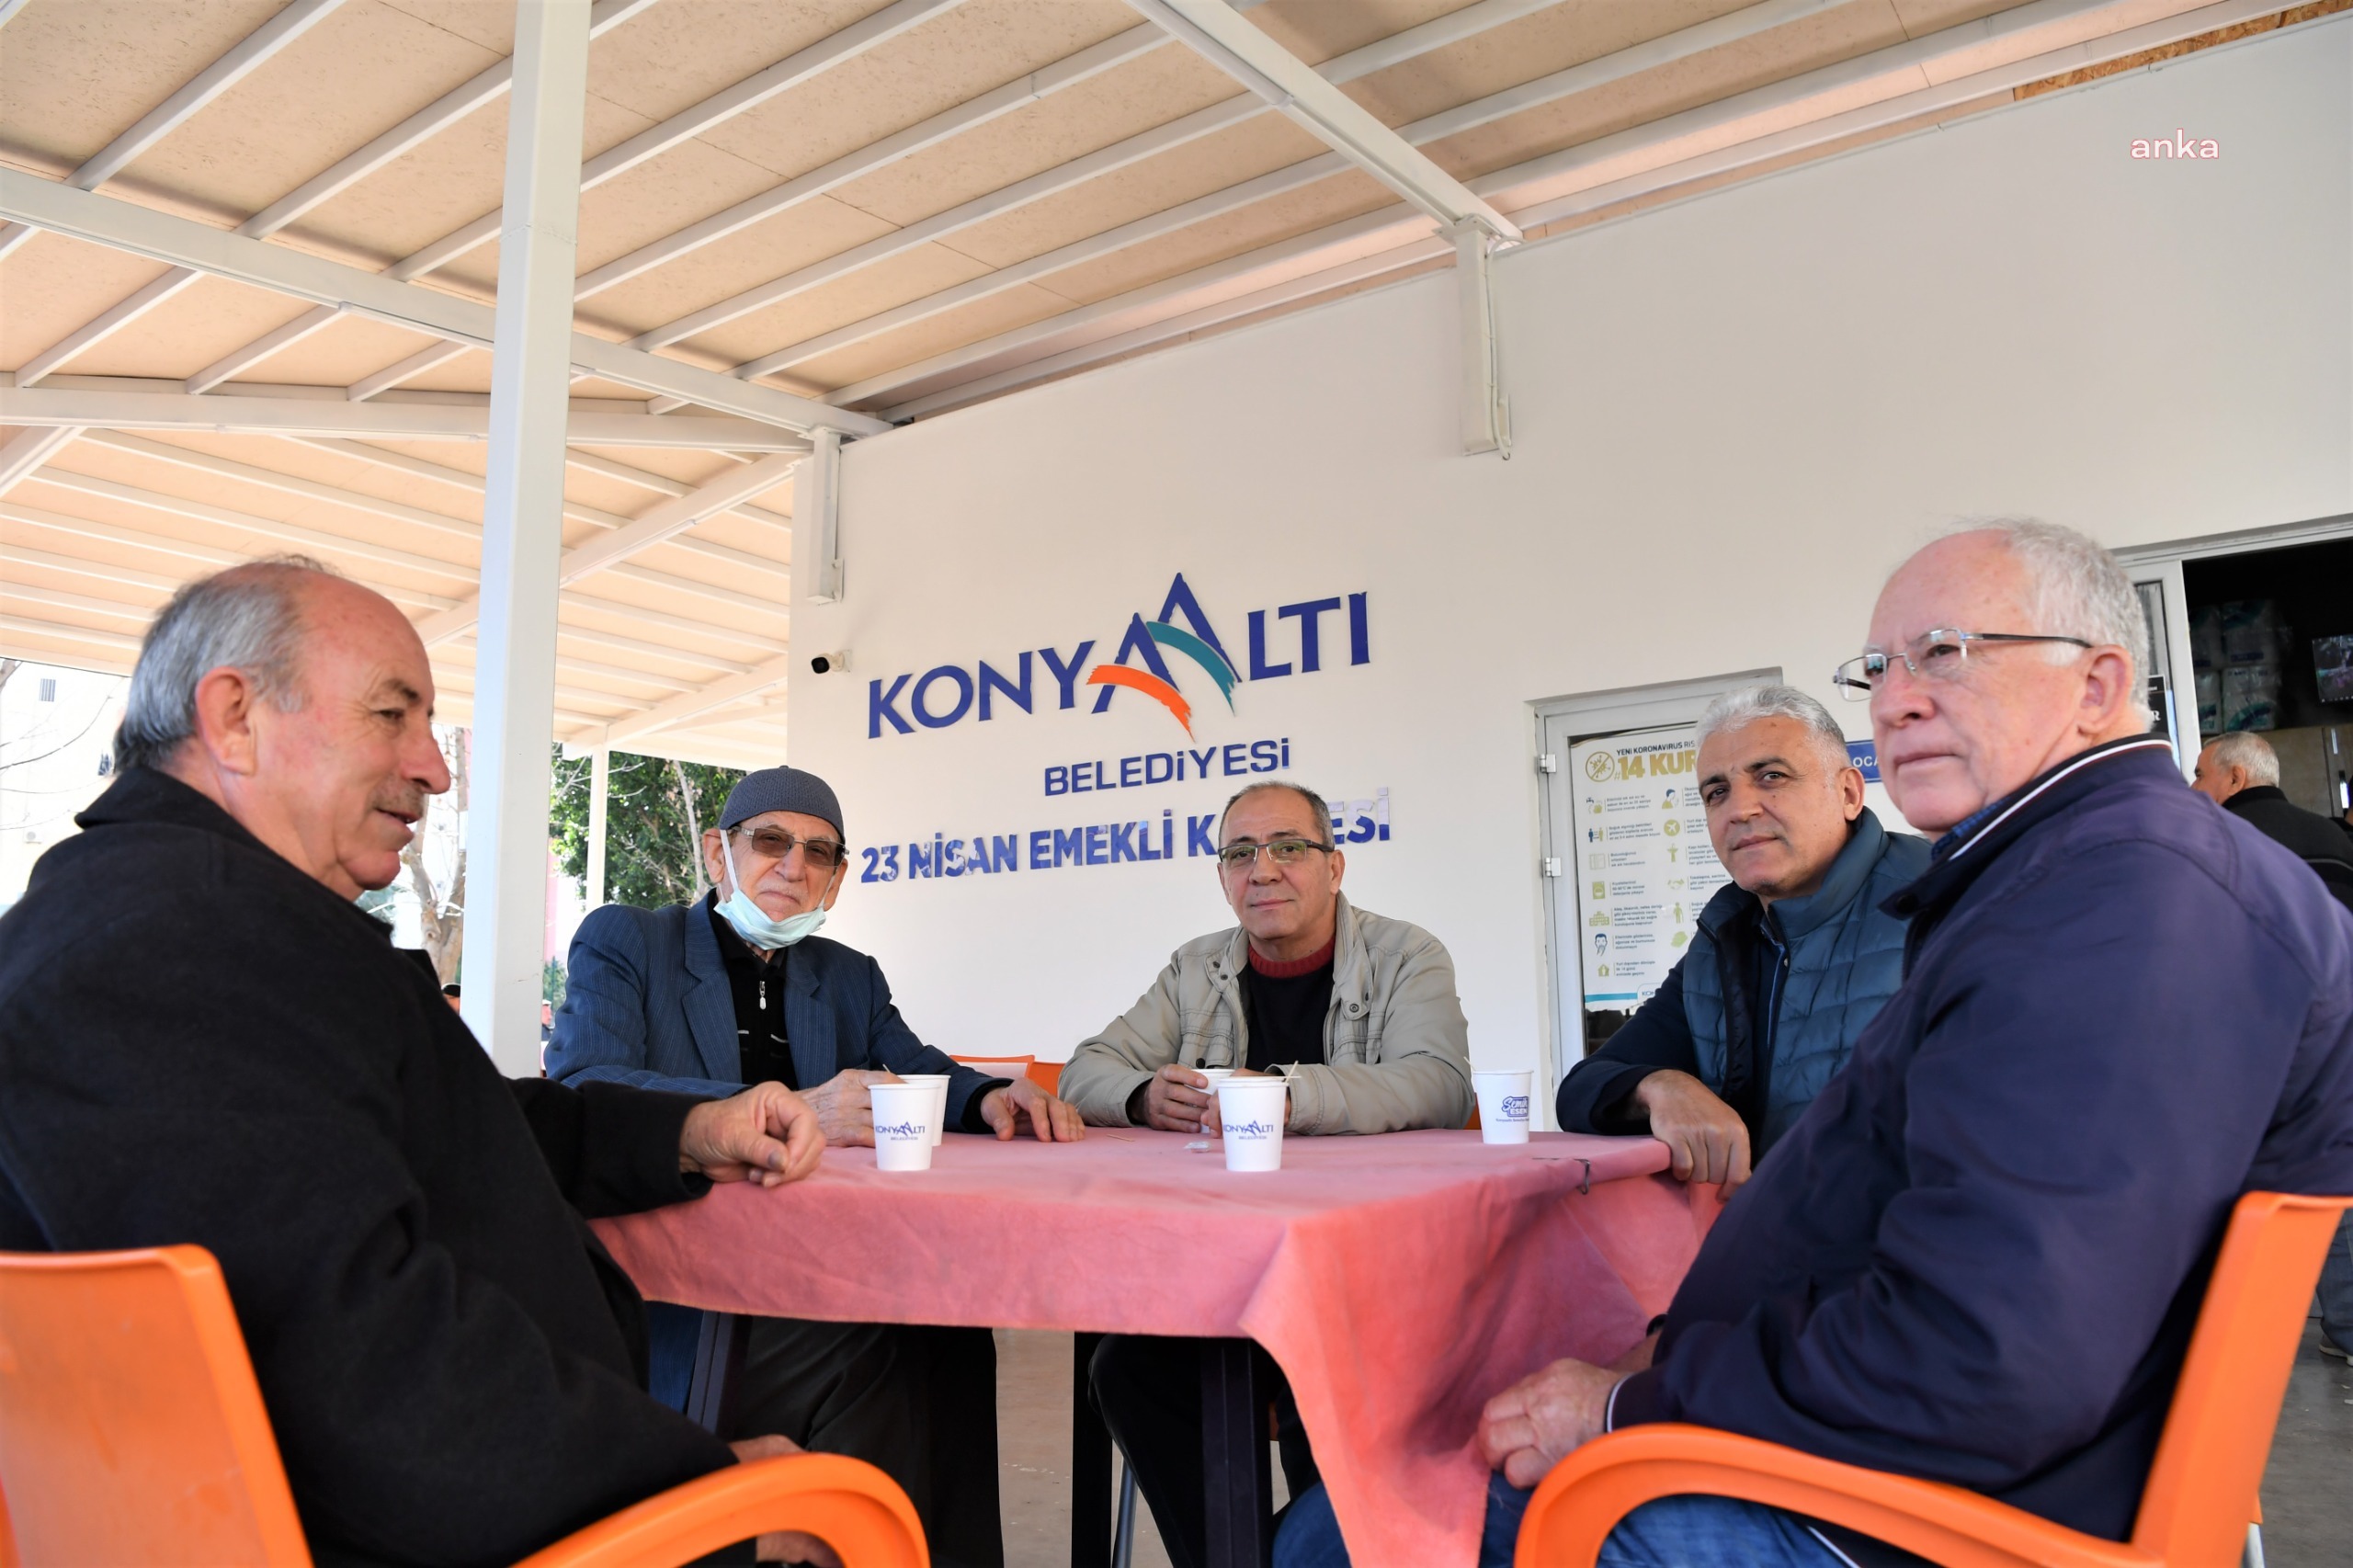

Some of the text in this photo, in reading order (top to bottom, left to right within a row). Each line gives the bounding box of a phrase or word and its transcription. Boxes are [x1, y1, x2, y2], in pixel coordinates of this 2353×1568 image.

[868, 572, 1370, 739] KONYAALTI
[1650, 749, 1697, 777] KUR
[861, 847, 900, 883] 23
[908, 832, 1018, 880] NİSAN
[1029, 808, 1173, 870] EMEKLİ
